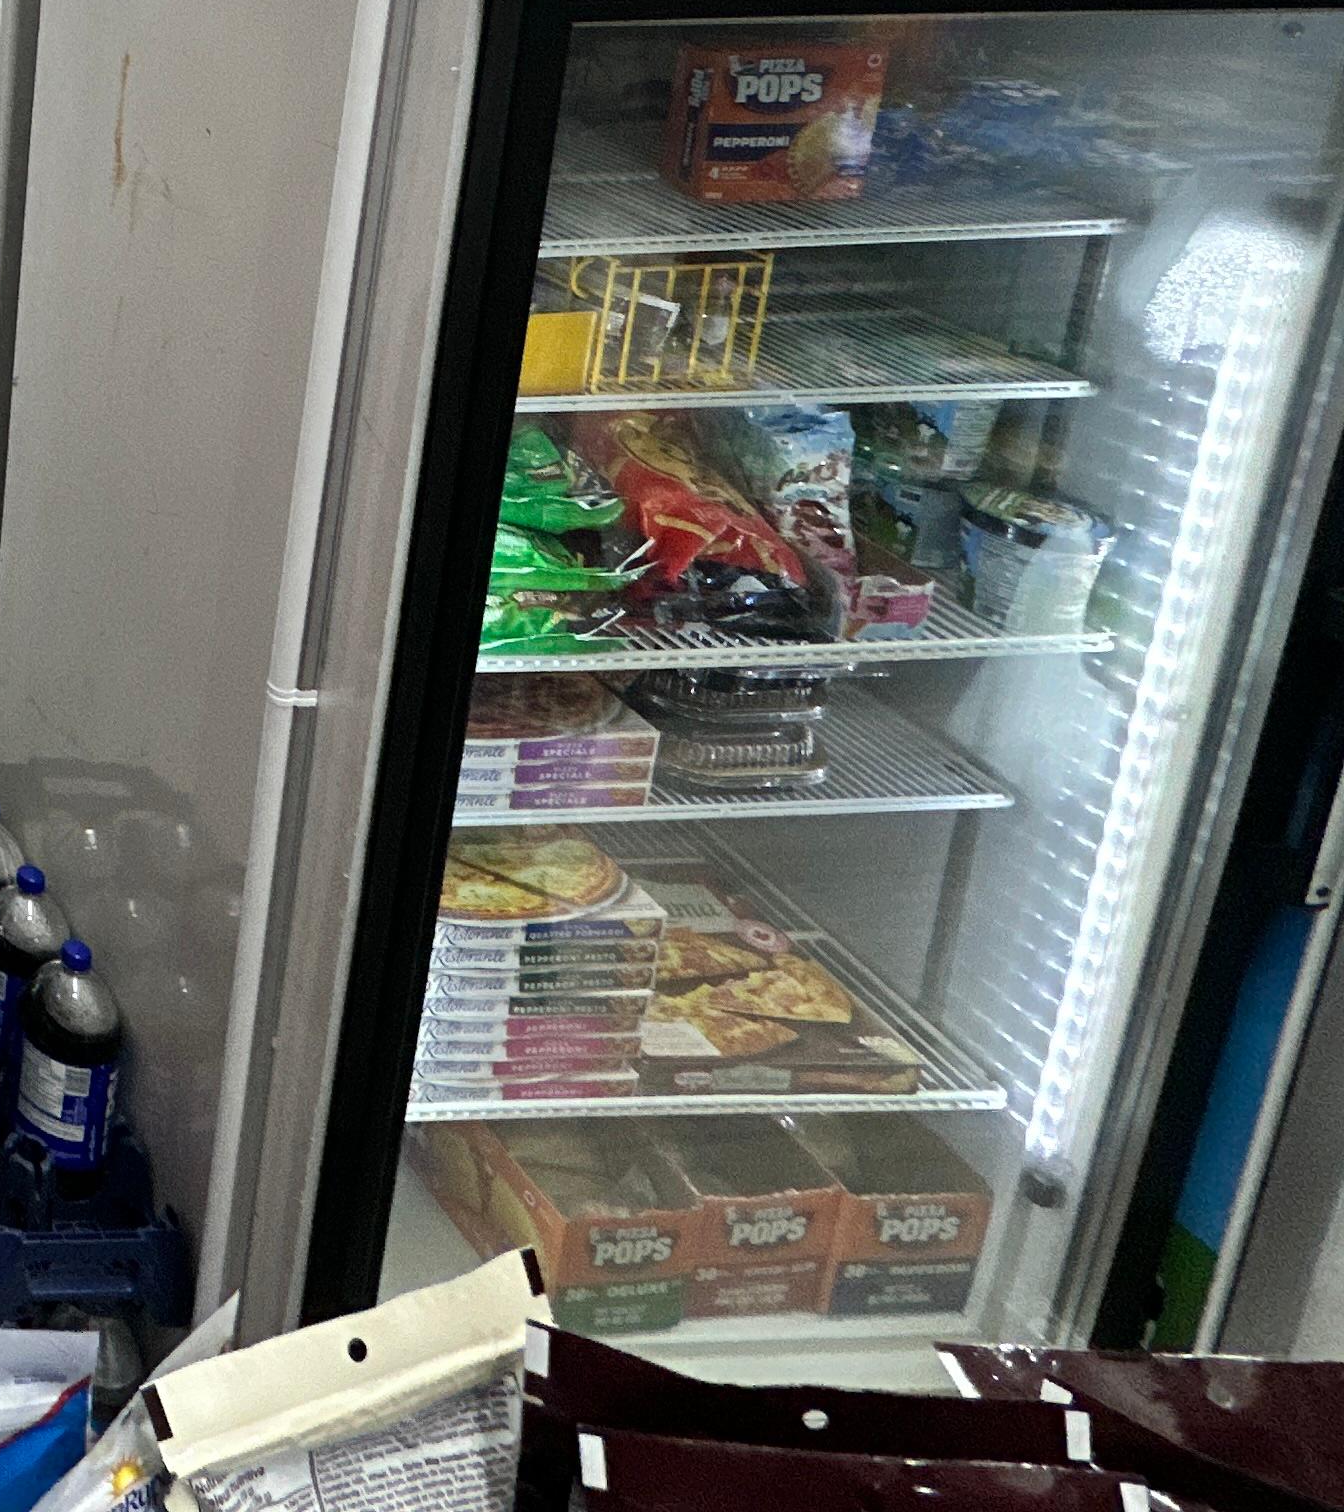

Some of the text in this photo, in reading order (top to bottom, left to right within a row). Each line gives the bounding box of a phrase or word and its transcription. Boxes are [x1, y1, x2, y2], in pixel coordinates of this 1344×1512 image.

[759, 58, 806, 73] PIZZA
[734, 72, 824, 105] POPS
[712, 135, 791, 149] PEPPERONI
[729, 1216, 808, 1247] POPS
[880, 1216, 961, 1243] POPS
[593, 1237, 674, 1267] POPS
